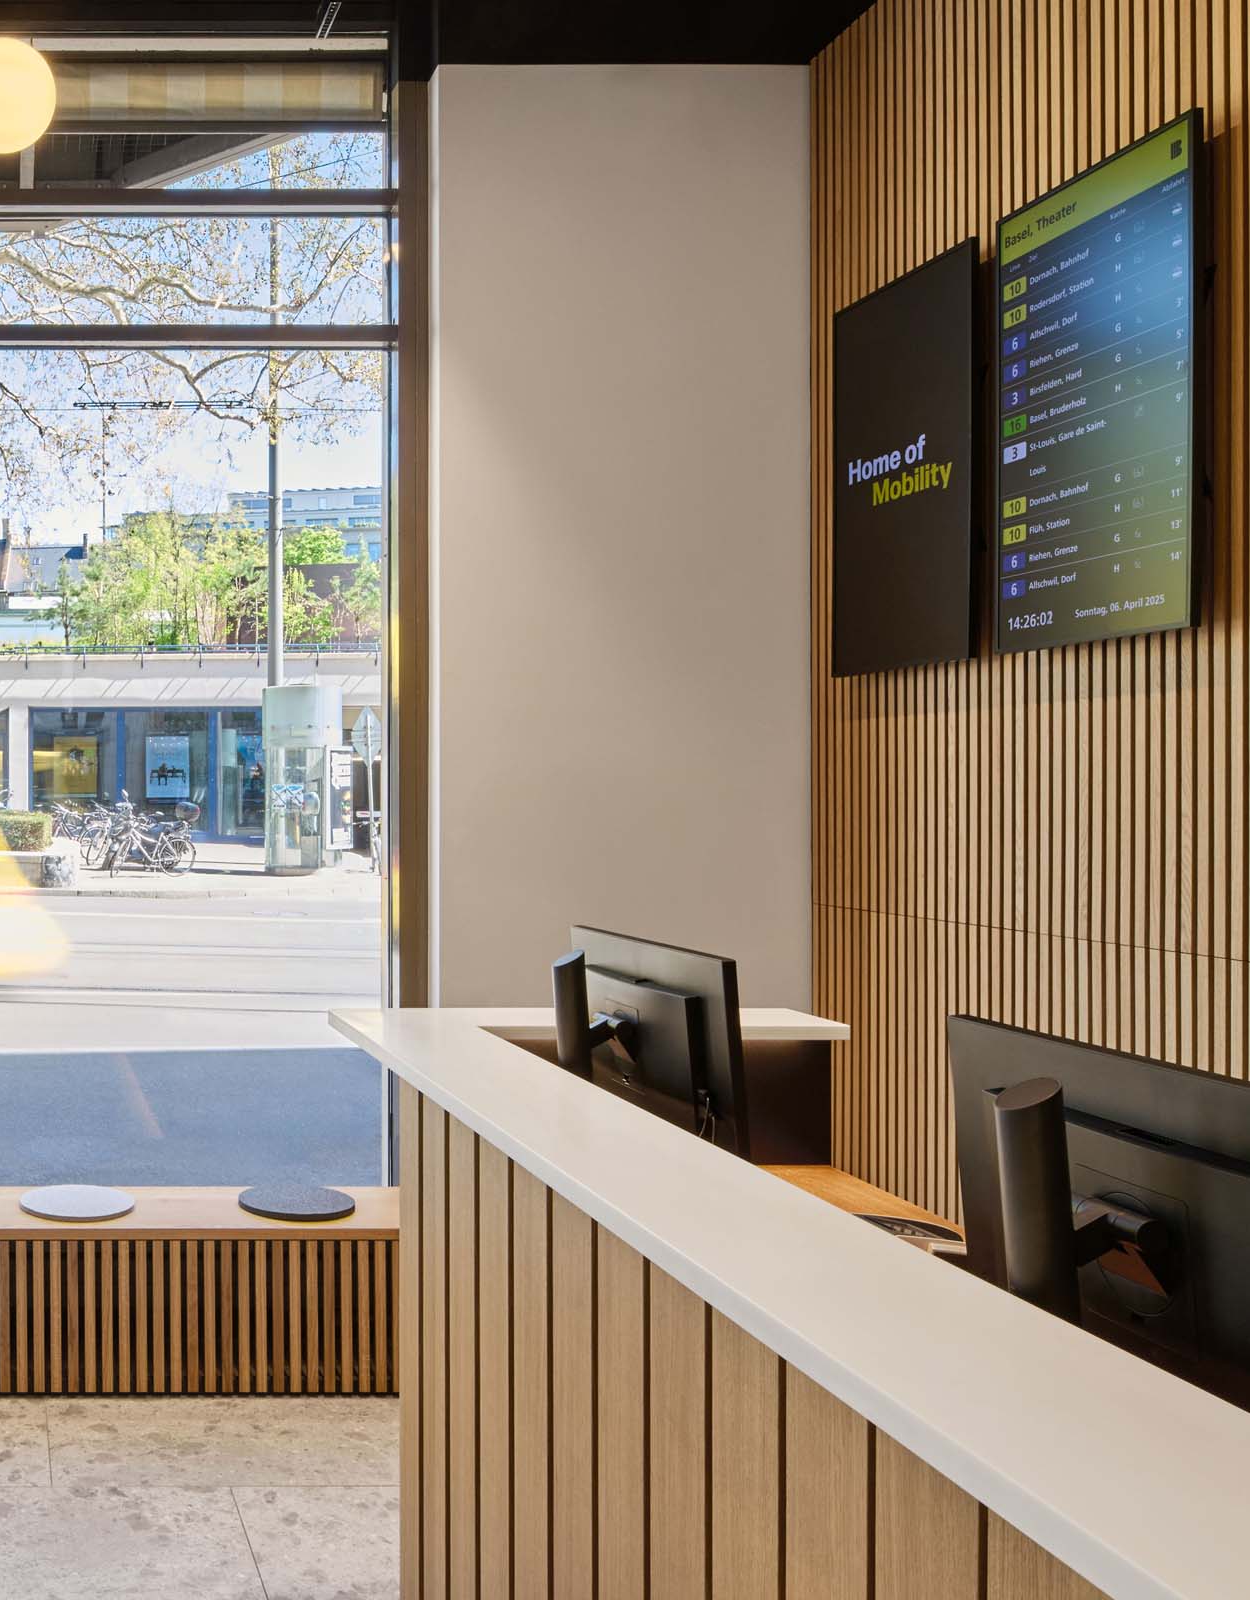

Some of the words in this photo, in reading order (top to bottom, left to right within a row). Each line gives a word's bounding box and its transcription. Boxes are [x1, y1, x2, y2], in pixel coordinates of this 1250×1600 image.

[1004, 224, 1033, 249] Basel,
[1036, 201, 1077, 231] Theater
[1010, 282, 1021, 296] 10
[1030, 265, 1058, 285] Dornach,
[1060, 248, 1089, 270] Bahnhof
[1114, 232, 1121, 242] G
[1010, 309, 1021, 323] 10
[1030, 288, 1067, 312] Rodersdorf,
[1069, 277, 1095, 294] Station
[1114, 263, 1121, 273] H
[1012, 337, 1018, 351] 6
[1030, 320, 1060, 340] Allschwil,
[1062, 312, 1078, 326] Dorf
[1012, 364, 1018, 377] 6
[1030, 353, 1053, 368] Riehen,
[1055, 342, 1079, 358] Grenze
[1114, 322, 1121, 333] G
[1011, 392, 1019, 405] 3
[1030, 377, 1063, 396] Birsfelden,
[1065, 368, 1082, 382] Hard
[1114, 353, 1121, 363] G
[1010, 419, 1021, 432] 16
[1030, 410, 1048, 424] Basel,
[1050, 396, 1086, 417] Bruderholz
[1114, 383, 1121, 392] H
[848, 449, 901, 485] Home
[904, 433, 926, 464] of
[1012, 446, 1018, 460] 3
[1058, 432, 1074, 442] Gare
[1075, 426, 1084, 436] de
[1086, 419, 1107, 433] Saint-
[872, 461, 952, 506] Mobility
[1030, 464, 1047, 477] Louis
[1010, 501, 1021, 514] 10
[1030, 492, 1058, 507] Dornach,
[1059, 481, 1089, 498] Bahnhof
[1114, 473, 1121, 483] G
[1009, 528, 1021, 541] 10
[1046, 518, 1070, 531] Station
[1114, 503, 1120, 513] H
[1011, 555, 1017, 569] 6
[1029, 551, 1053, 562] Riehen,
[1054, 545, 1079, 556] Grenze
[1011, 583, 1017, 596] 6
[1029, 576, 1059, 590] Allschwil,
[1061, 571, 1077, 584] Dorf
[1113, 563, 1120, 573] H
[1007, 610, 1053, 631] 14:26:02
[1075, 606, 1108, 618] Sonntag,
[1110, 602, 1122, 612] 06.
[1124, 596, 1143, 610] April
[1145, 593, 1165, 607] 2025
